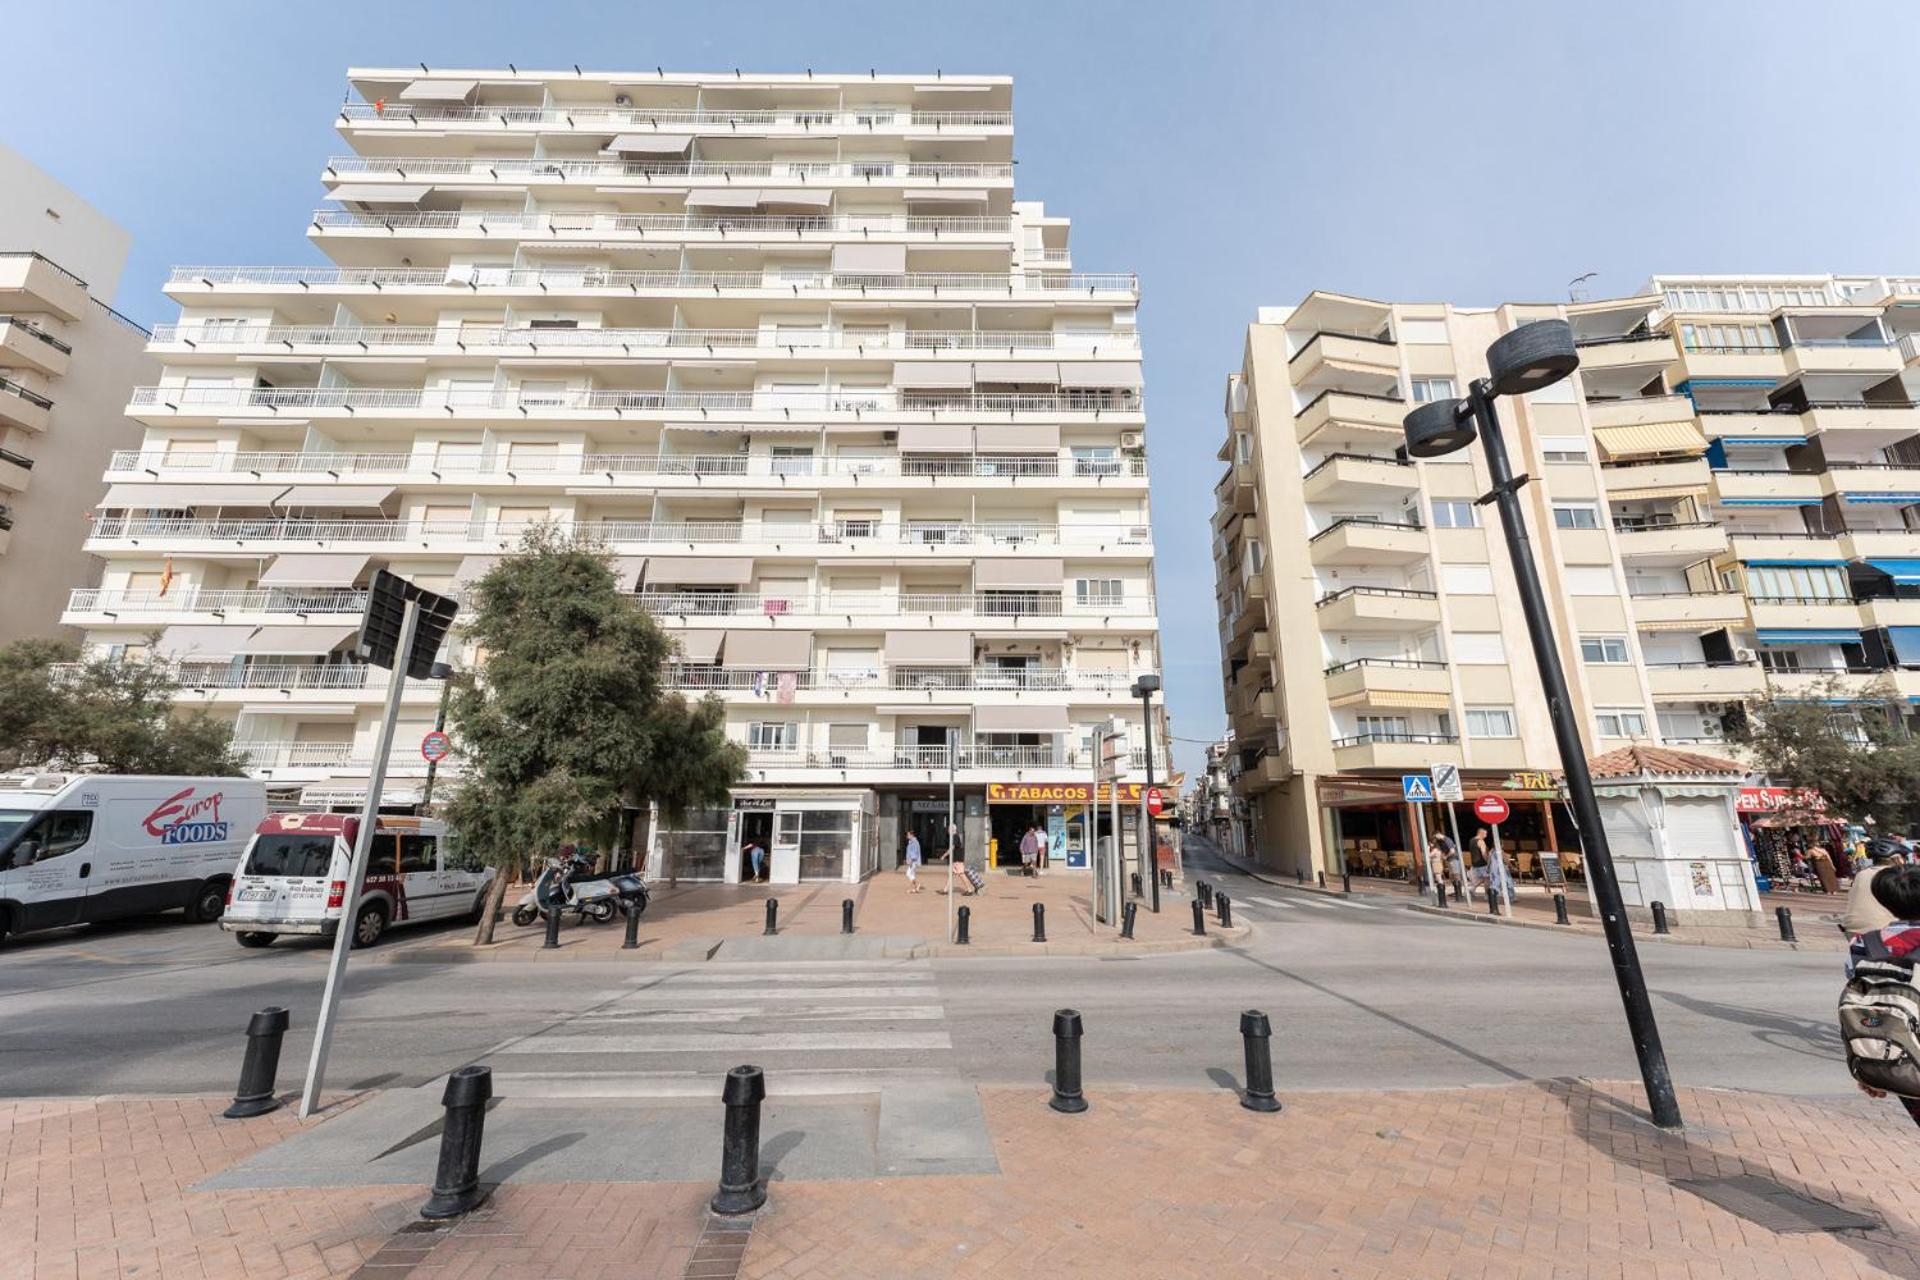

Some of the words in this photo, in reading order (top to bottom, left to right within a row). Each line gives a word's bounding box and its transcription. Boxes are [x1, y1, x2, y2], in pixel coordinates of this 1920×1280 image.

[1008, 788, 1087, 799] TABACOS
[1734, 794, 1759, 808] PEN
[142, 787, 223, 836] Europ
[164, 823, 226, 843] FOODS
